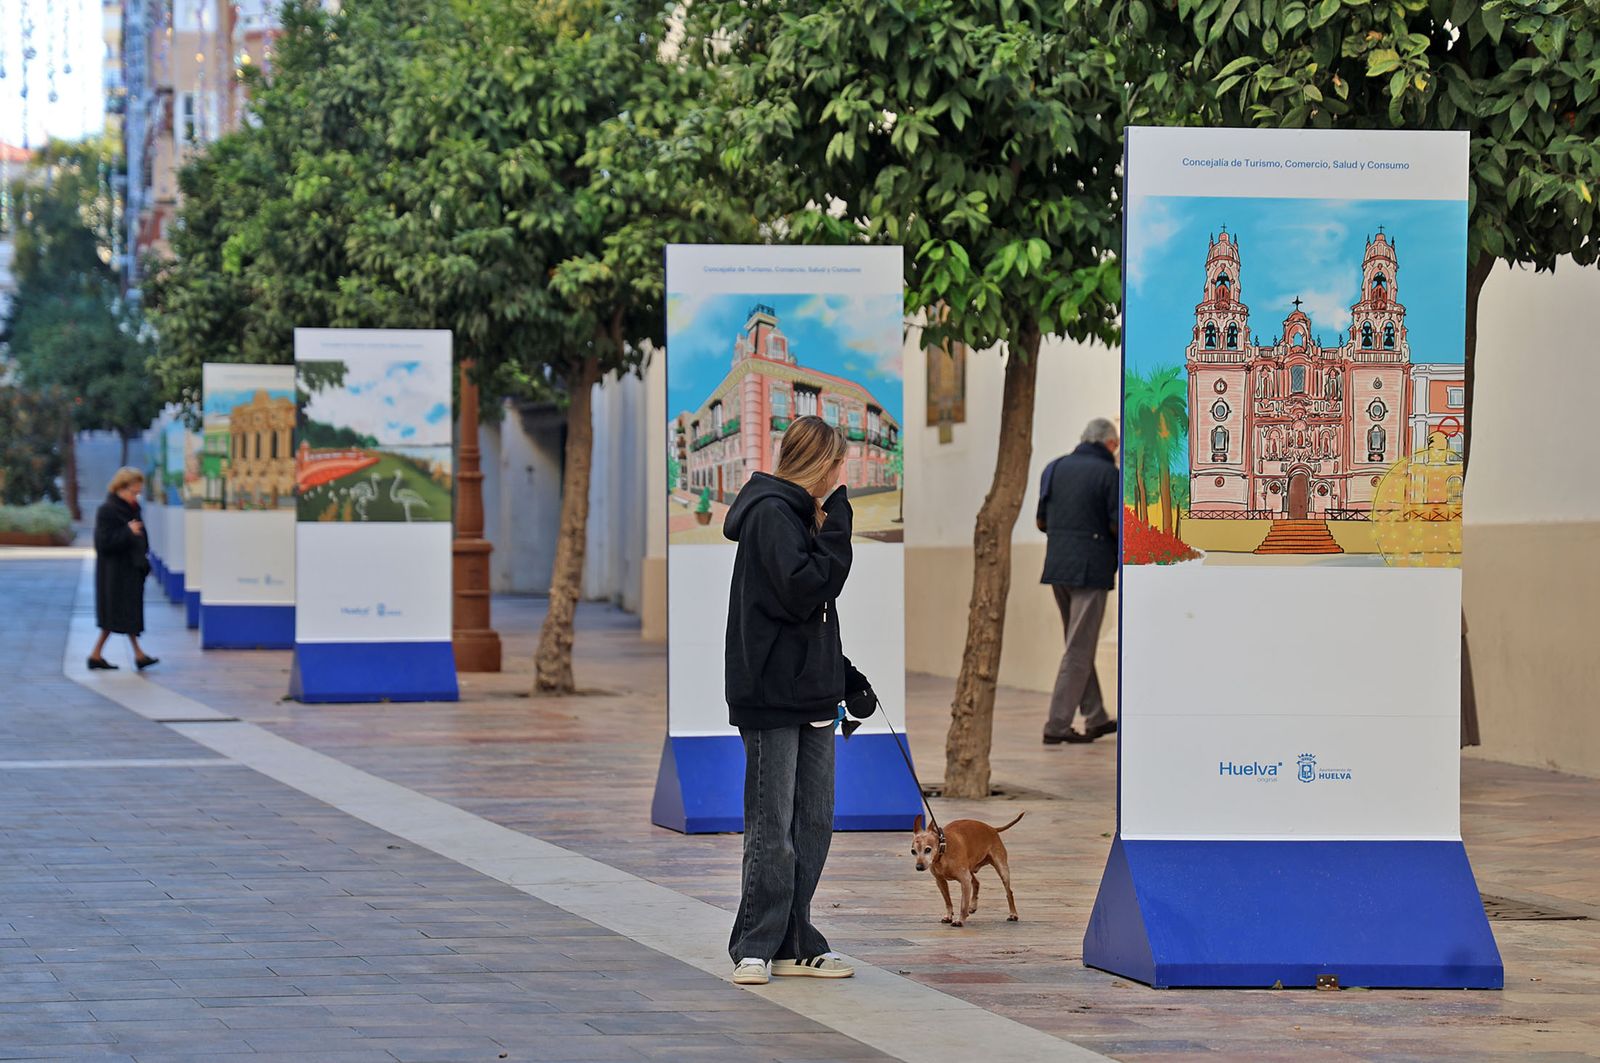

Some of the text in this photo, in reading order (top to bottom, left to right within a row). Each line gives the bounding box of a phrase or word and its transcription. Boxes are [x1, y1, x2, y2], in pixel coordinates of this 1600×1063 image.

[1182, 157, 1410, 171] Concejalía de Turismo, Comercio, Salud y Consumo
[1219, 761, 1278, 776] Huelva
[1318, 772, 1352, 780] HUELVA
